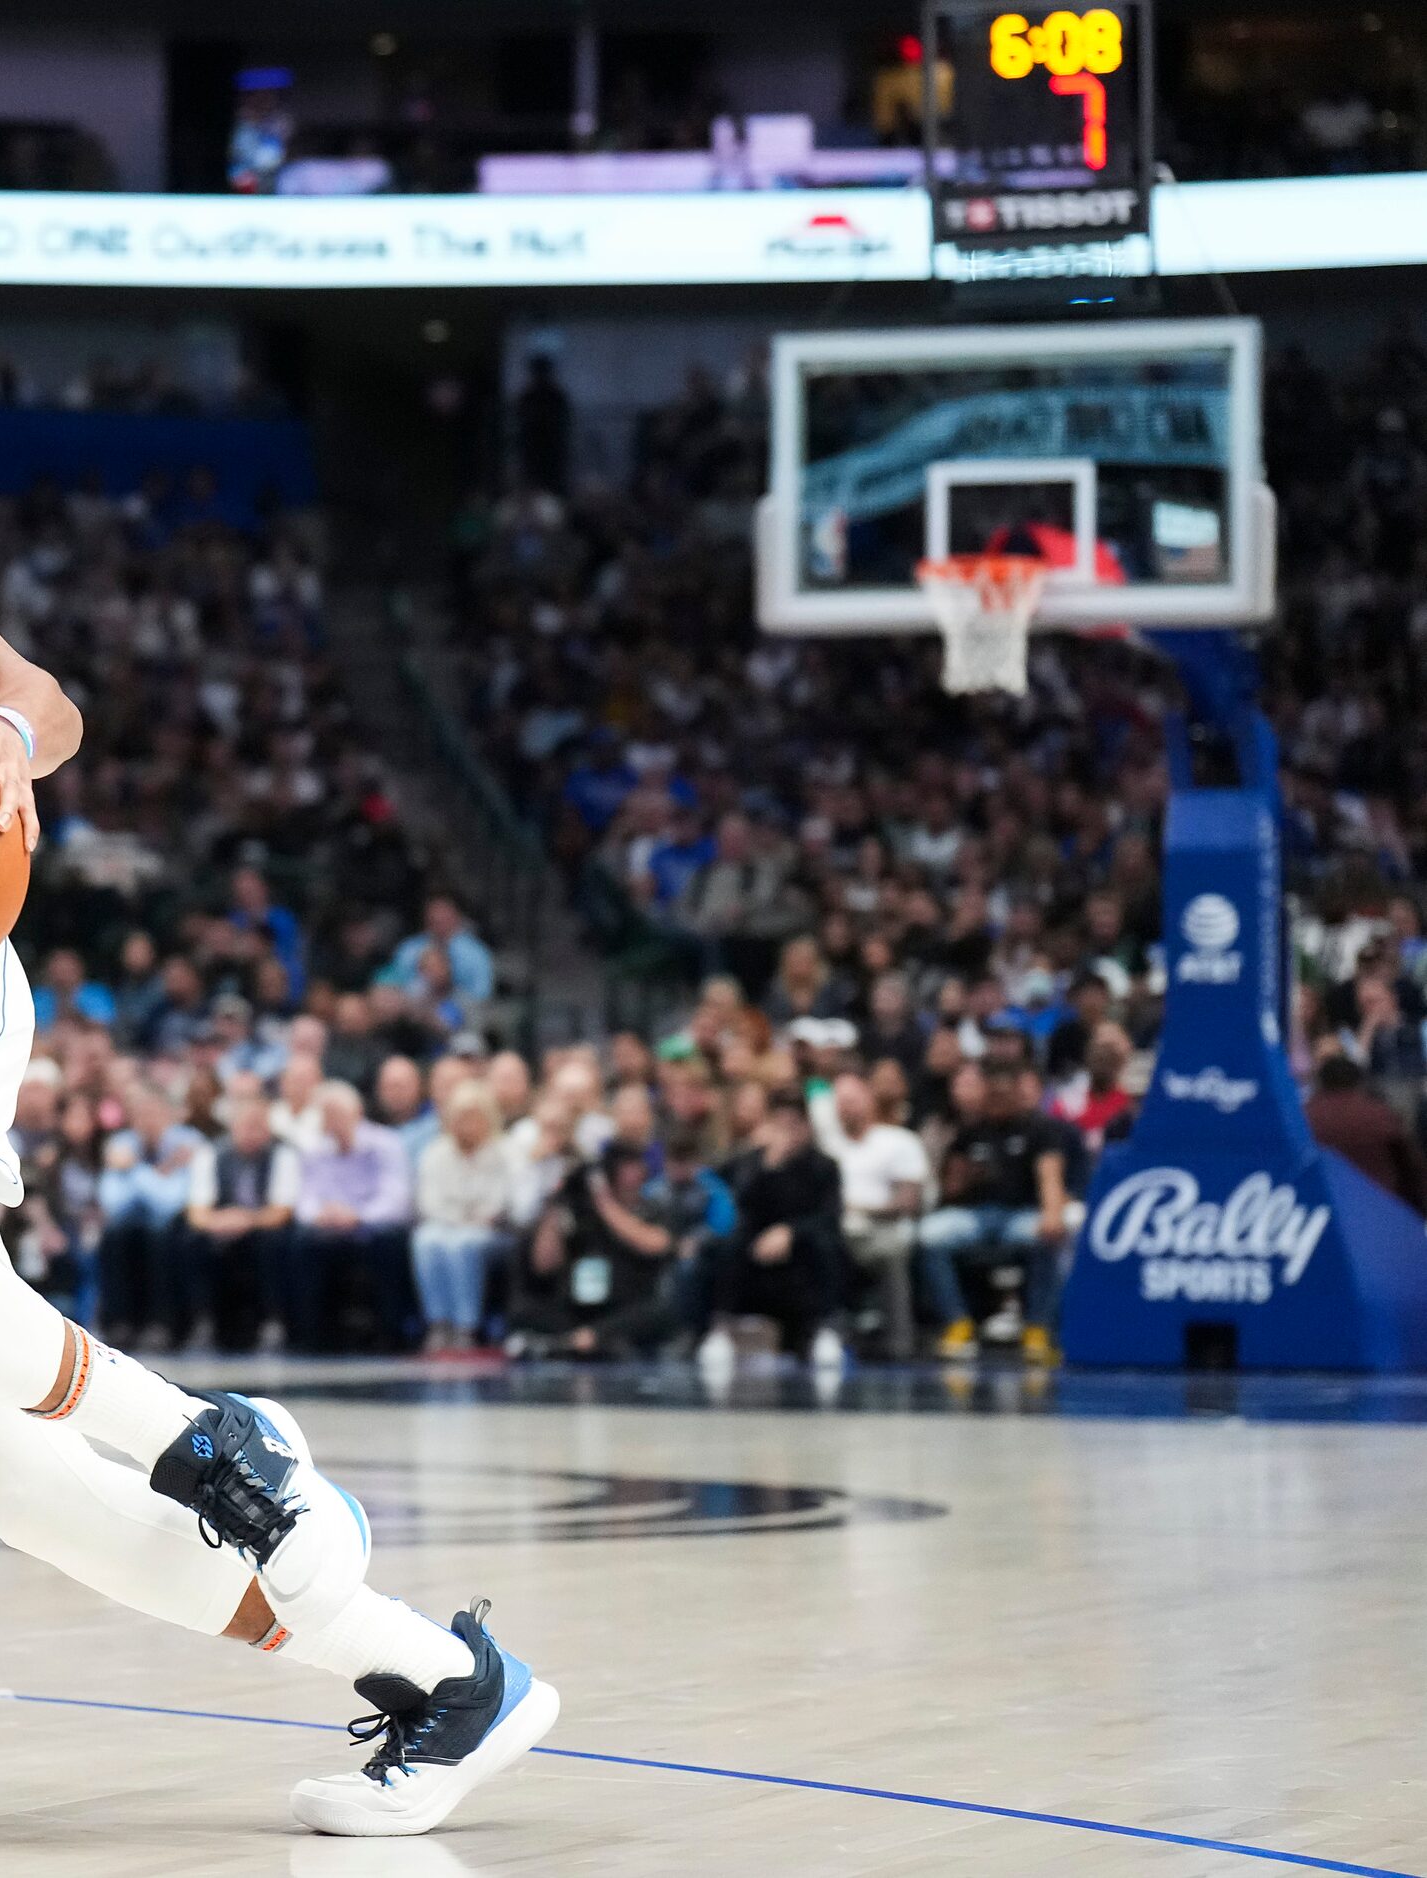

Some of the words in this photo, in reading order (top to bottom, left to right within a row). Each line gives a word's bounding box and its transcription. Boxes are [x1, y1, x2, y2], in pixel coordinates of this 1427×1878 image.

[990, 9, 1123, 80] 6:08
[1049, 73, 1107, 171] 7
[998, 189, 1137, 230] TISSOT
[1089, 1166, 1332, 1287] Bally
[1140, 1257, 1274, 1303] SPORTS
